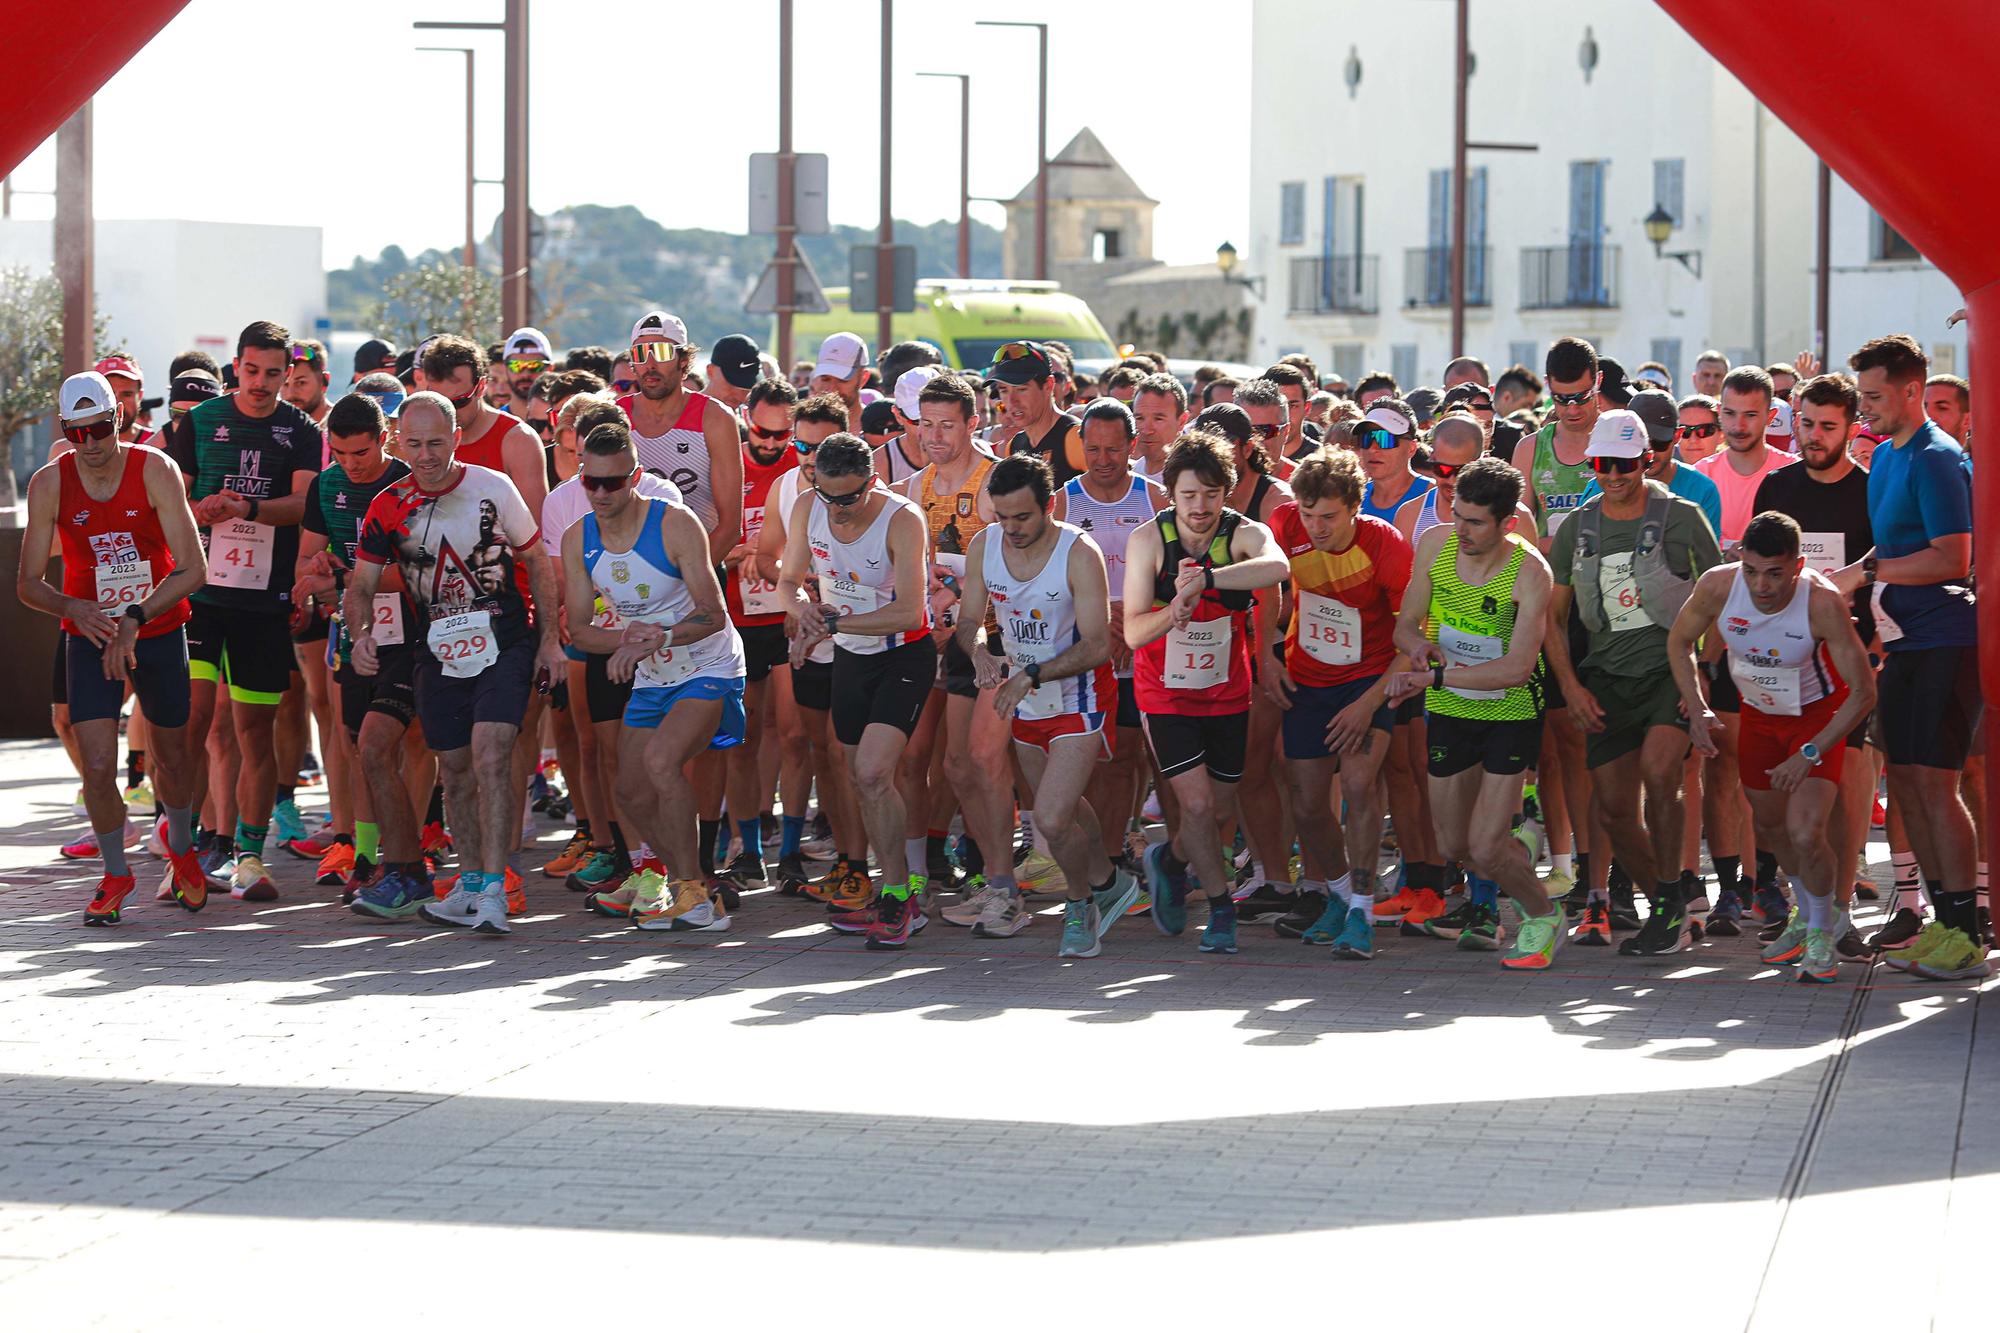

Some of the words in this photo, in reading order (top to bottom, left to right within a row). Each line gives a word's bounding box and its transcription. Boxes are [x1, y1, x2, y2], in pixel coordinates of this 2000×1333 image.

[224, 478, 271, 495] FIRME
[232, 523, 256, 535] 2023
[1800, 543, 1824, 553] 2023
[224, 547, 255, 568] 41
[111, 563, 136, 575] 2023
[101, 582, 151, 604] 267
[1319, 605, 1343, 618] 2023
[445, 615, 469, 629] 2023
[1188, 631, 1213, 640] 2023
[1309, 623, 1353, 648] 181
[438, 635, 487, 660] 229
[1456, 640, 1480, 653] 2023
[1184, 652, 1215, 670] 12
